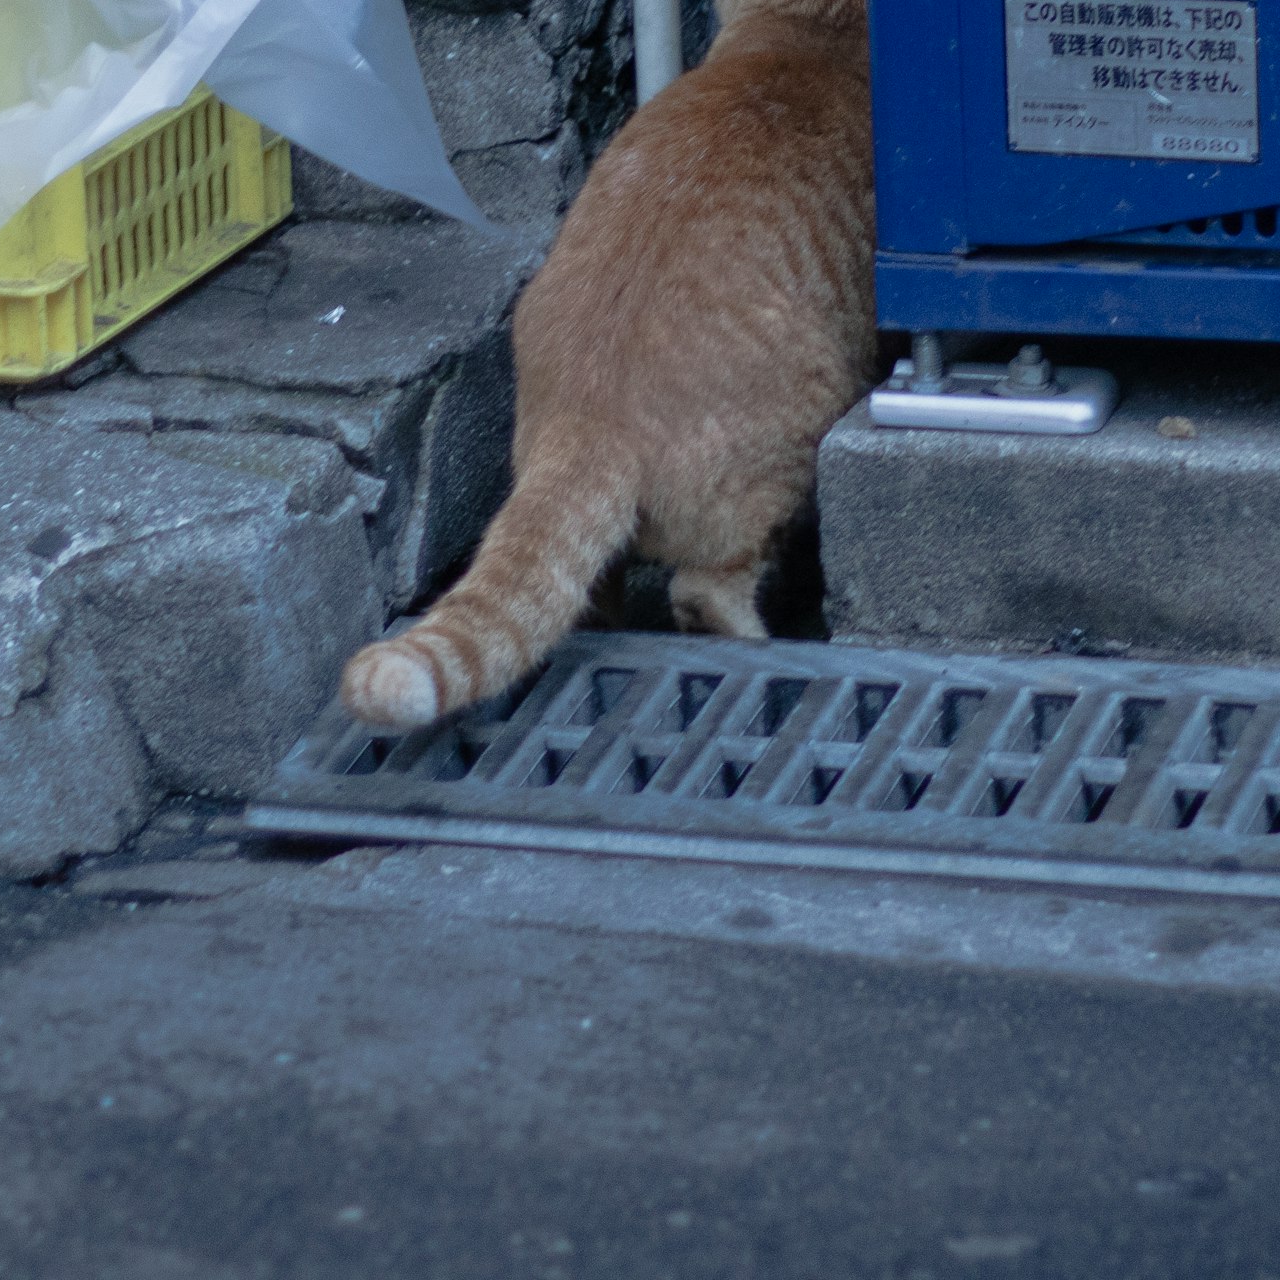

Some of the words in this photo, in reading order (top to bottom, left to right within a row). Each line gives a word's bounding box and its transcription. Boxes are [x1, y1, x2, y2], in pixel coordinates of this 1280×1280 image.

[1023, 2, 1243, 31] この自動販売機は、下記の
[1048, 32, 1245, 64] 管理者の許可なく売却、
